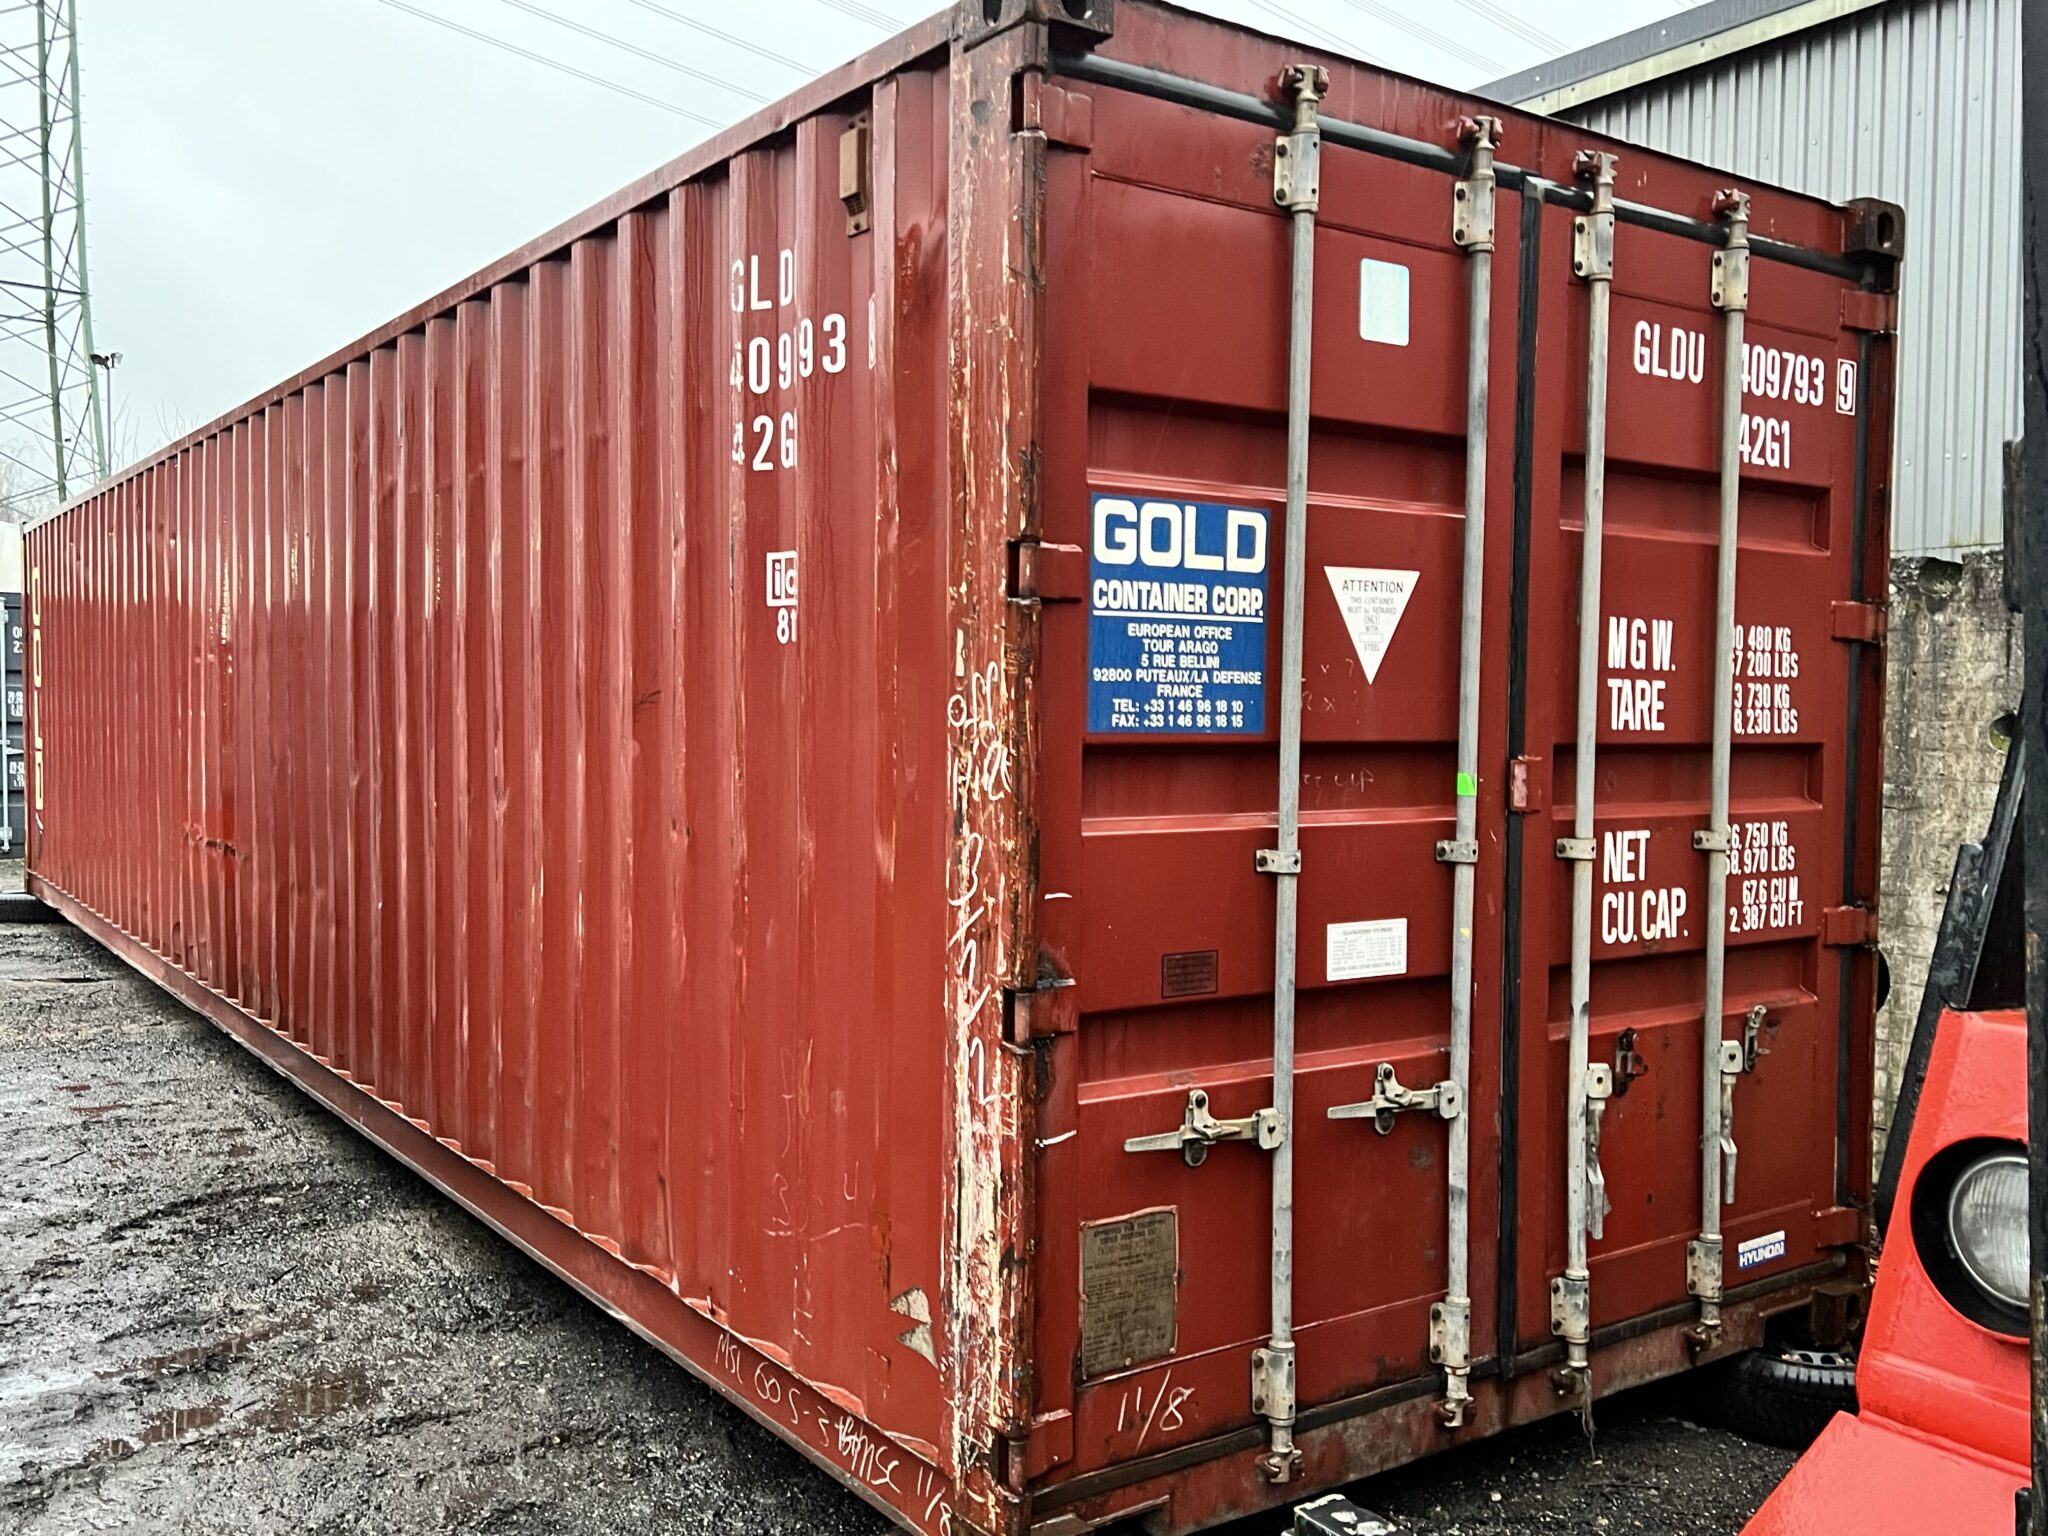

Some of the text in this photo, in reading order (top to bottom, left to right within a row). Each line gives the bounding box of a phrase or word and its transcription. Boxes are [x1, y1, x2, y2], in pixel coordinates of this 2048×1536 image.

[1633, 320, 1706, 384] GLDU
[1838, 362, 1854, 411] 9
[1739, 413, 1790, 469] 42G1
[1093, 498, 1267, 574] GOLD
[1093, 579, 1264, 616] CONTAINER CORP.
[1342, 579, 1403, 593] ATTENTION
[1127, 623, 1232, 640] EUROPEAN OFFICE
[1748, 625, 1772, 652] 480
[1775, 627, 1791, 652] KG
[1142, 639, 1218, 654] TOUR ARAGO
[1141, 654, 1219, 669] 5 RUE BELLINI
[1747, 651, 1772, 677] 200
[1774, 652, 1798, 678] LBS
[1093, 668, 1262, 685] 92800 PUTEAUX/LA DEFENSE
[1157, 684, 1203, 698] FRANCE
[1607, 678, 1666, 731] TARE
[1734, 683, 1790, 709] 3 730 KG
[1112, 699, 1243, 713] TEL: +33 1 46 96 18 10
[1111, 714, 1243, 727] FAX: +33 1 46 96 18 15
[1774, 708, 1798, 734] LBS
[1771, 821, 1788, 847] KG
[1603, 830, 1651, 883] NET
[1771, 845, 1795, 872] LBS
[1770, 878, 1787, 903] CU
[1789, 875, 1799, 902] M
[1770, 902, 1786, 928] CU
[1788, 900, 1804, 926] FT
[1740, 1241, 1784, 1268] HYUNDAI
[1117, 1369, 1196, 1451] 11/8
